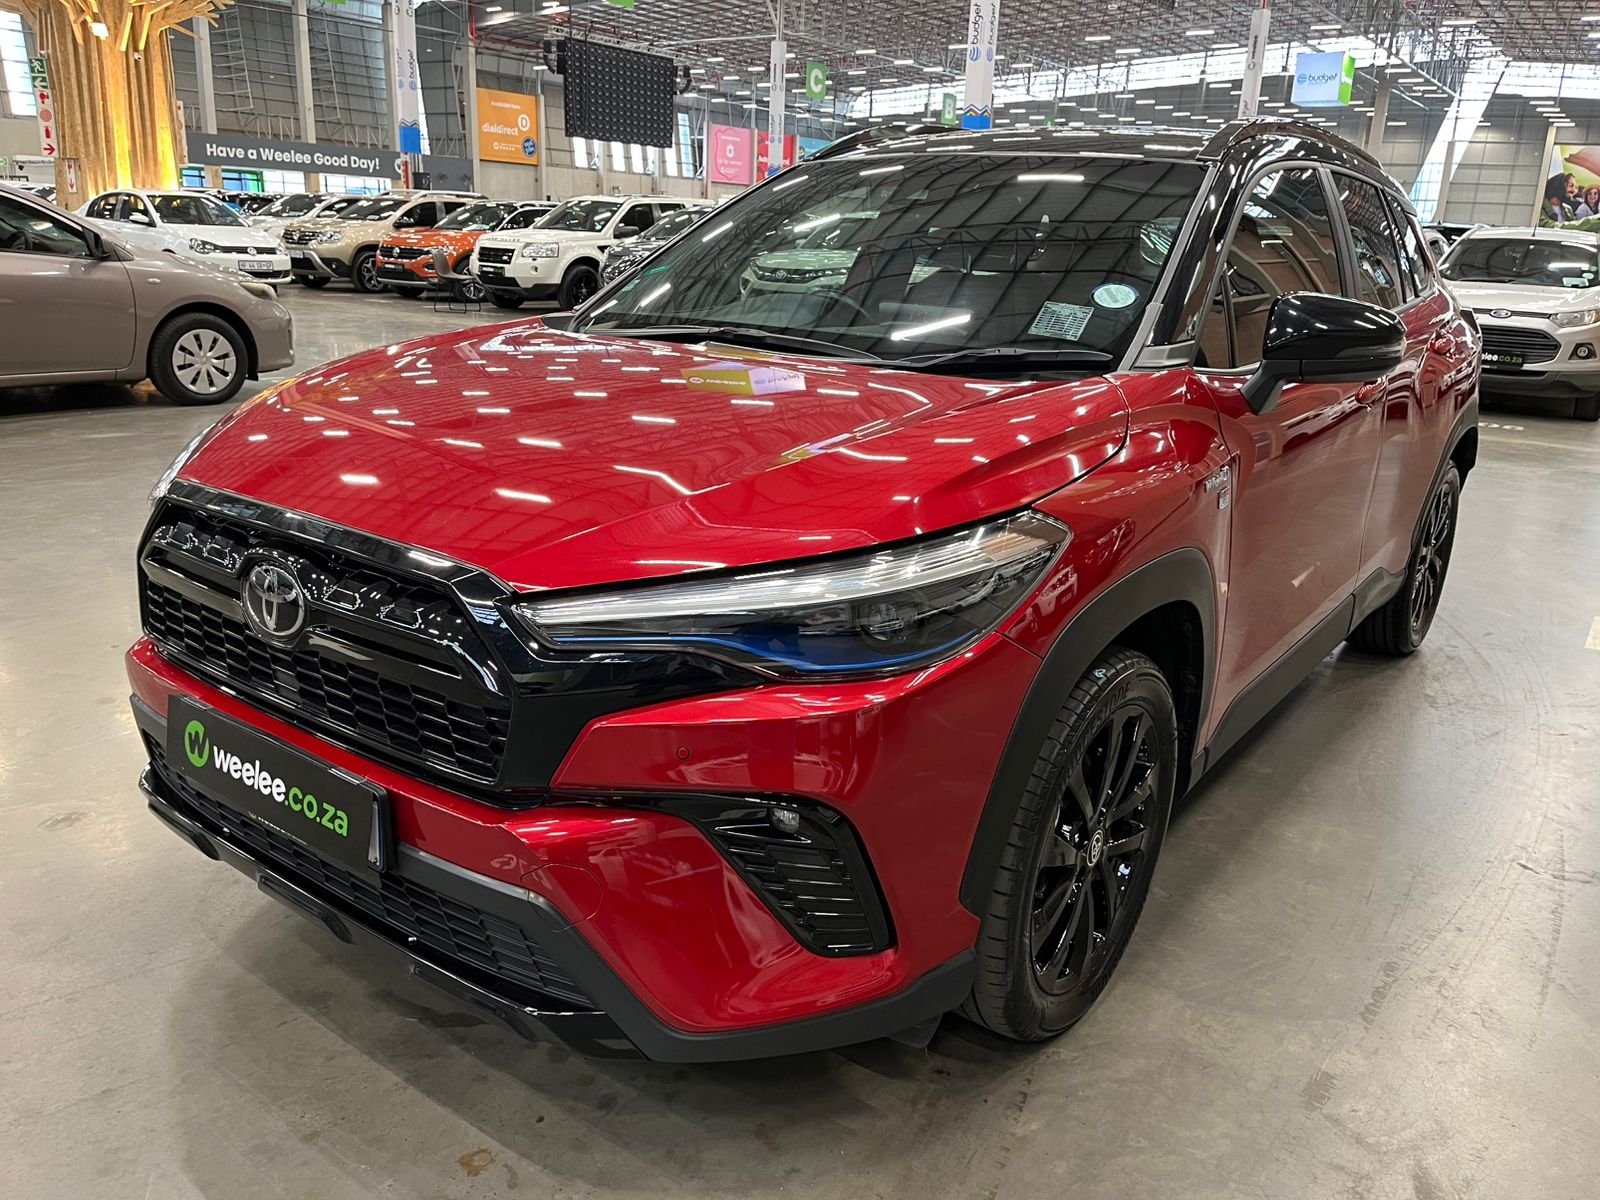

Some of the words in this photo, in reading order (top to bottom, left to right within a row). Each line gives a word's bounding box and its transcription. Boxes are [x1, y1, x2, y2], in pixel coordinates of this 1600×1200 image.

[970, 2, 983, 45] budget
[988, 3, 996, 45] budget
[810, 68, 823, 93] C
[1308, 72, 1337, 84] budget
[944, 98, 953, 119] B
[482, 122, 519, 137] dialdirect
[206, 143, 245, 159] Have
[248, 149, 257, 160] a
[260, 147, 311, 164] Weelee
[314, 152, 348, 167] Good
[351, 156, 380, 173] Day!
[213, 745, 349, 837] weelee.co.za
